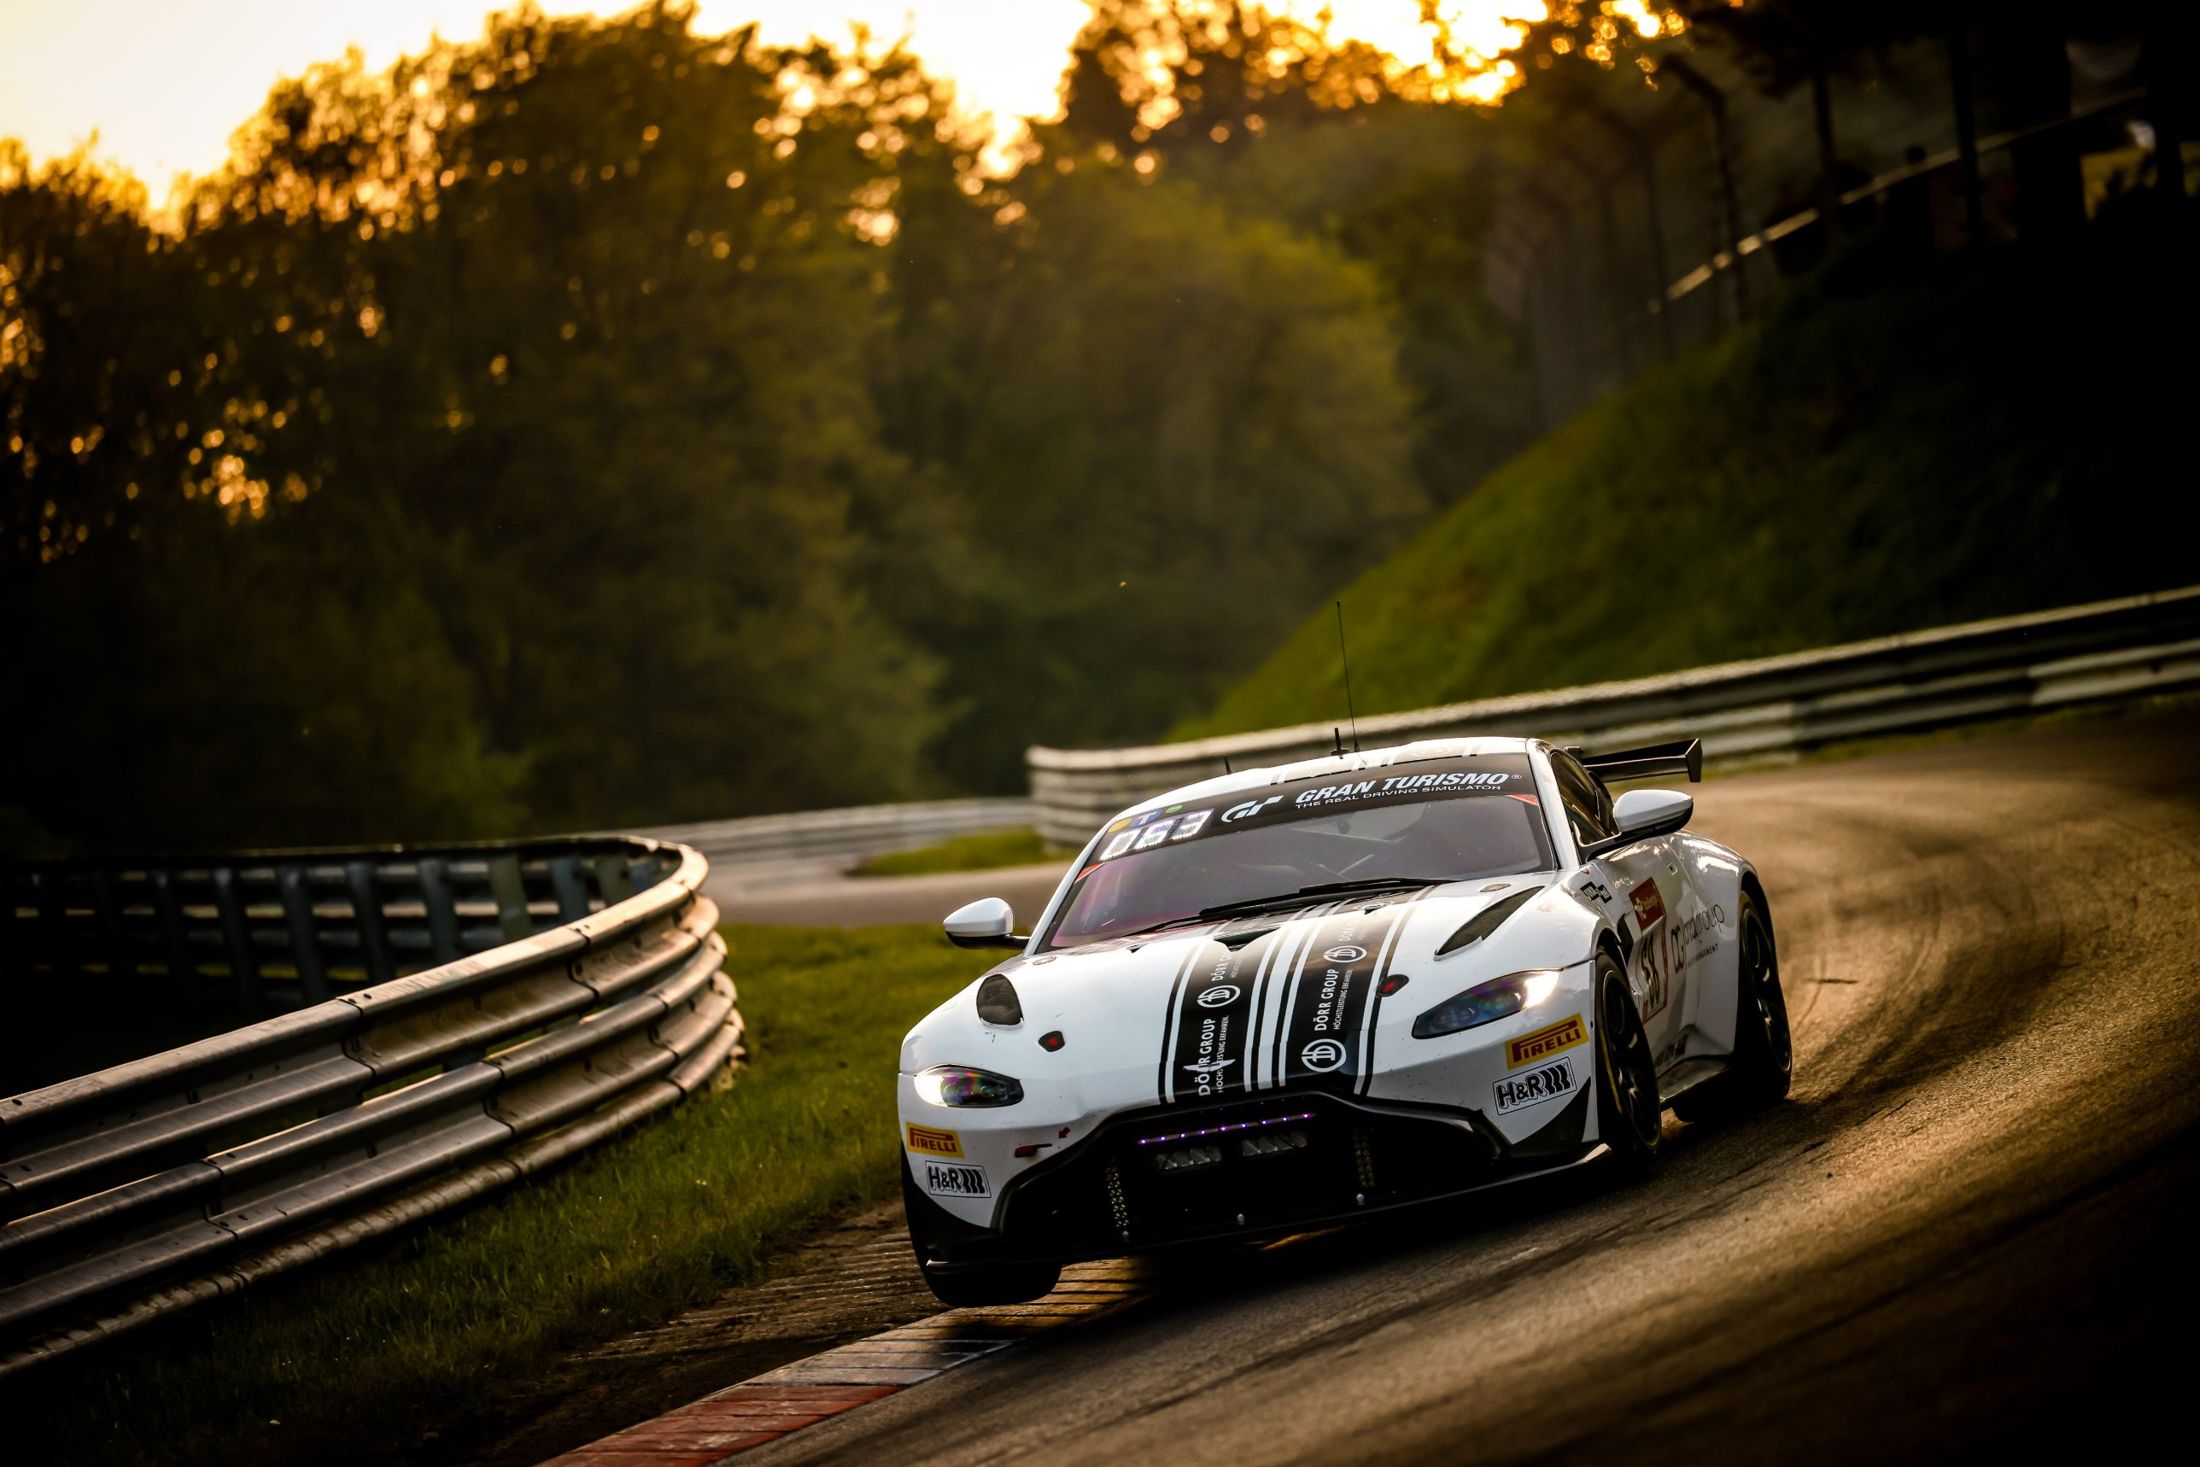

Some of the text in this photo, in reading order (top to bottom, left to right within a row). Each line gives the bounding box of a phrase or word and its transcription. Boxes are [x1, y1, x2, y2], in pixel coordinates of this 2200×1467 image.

[1295, 773, 1509, 803] GRAN TURISMO
[1295, 785, 1501, 809] THE REAL DRIVING SIMULATOR
[1313, 968, 1339, 1031] DÖRR GROUP
[1194, 1018, 1216, 1096] DÖR GROUP
[1511, 1019, 1581, 1063] PIRELLI
[1495, 1074, 1548, 1109] H&R
[909, 1127, 957, 1153] PIRELLI
[927, 1166, 962, 1192] H&R
